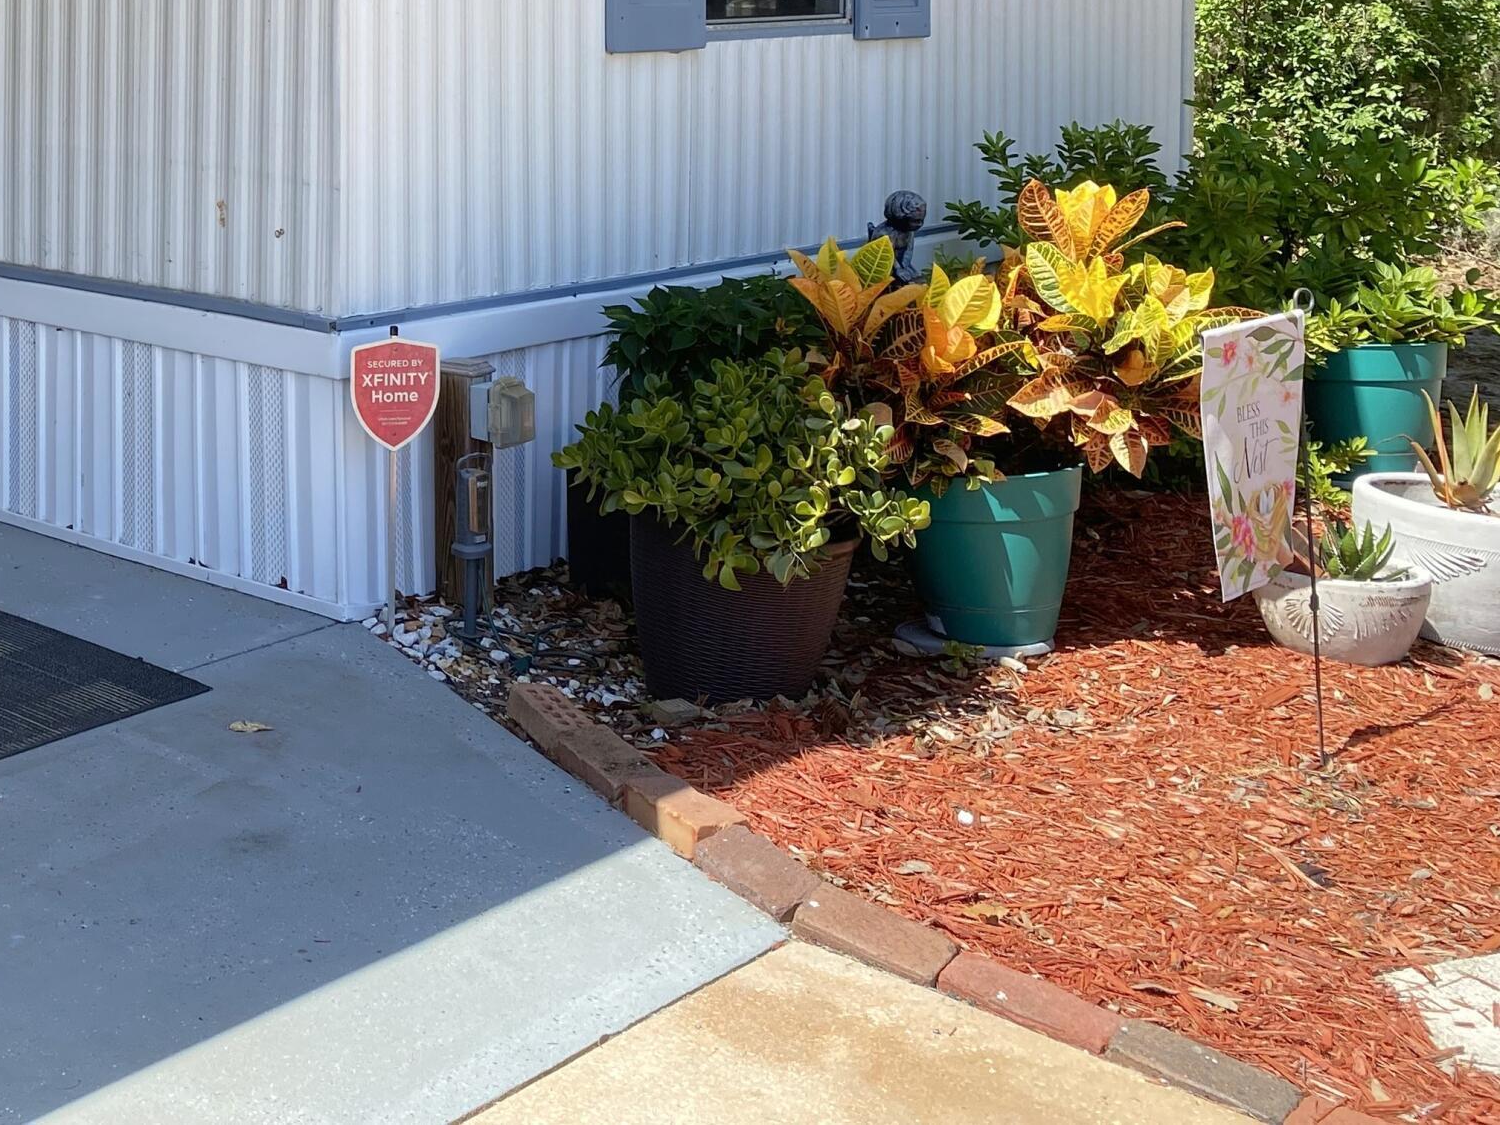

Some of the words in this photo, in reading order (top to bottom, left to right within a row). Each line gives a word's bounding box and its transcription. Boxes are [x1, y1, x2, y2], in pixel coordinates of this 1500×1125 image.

[367, 359, 409, 369] SECURED
[411, 359, 423, 367] BY
[362, 371, 429, 387] XFINITY
[371, 390, 419, 403] Home
[1236, 401, 1261, 424] BLESS
[1250, 418, 1269, 440] THIS
[1233, 436, 1278, 484] Nest
